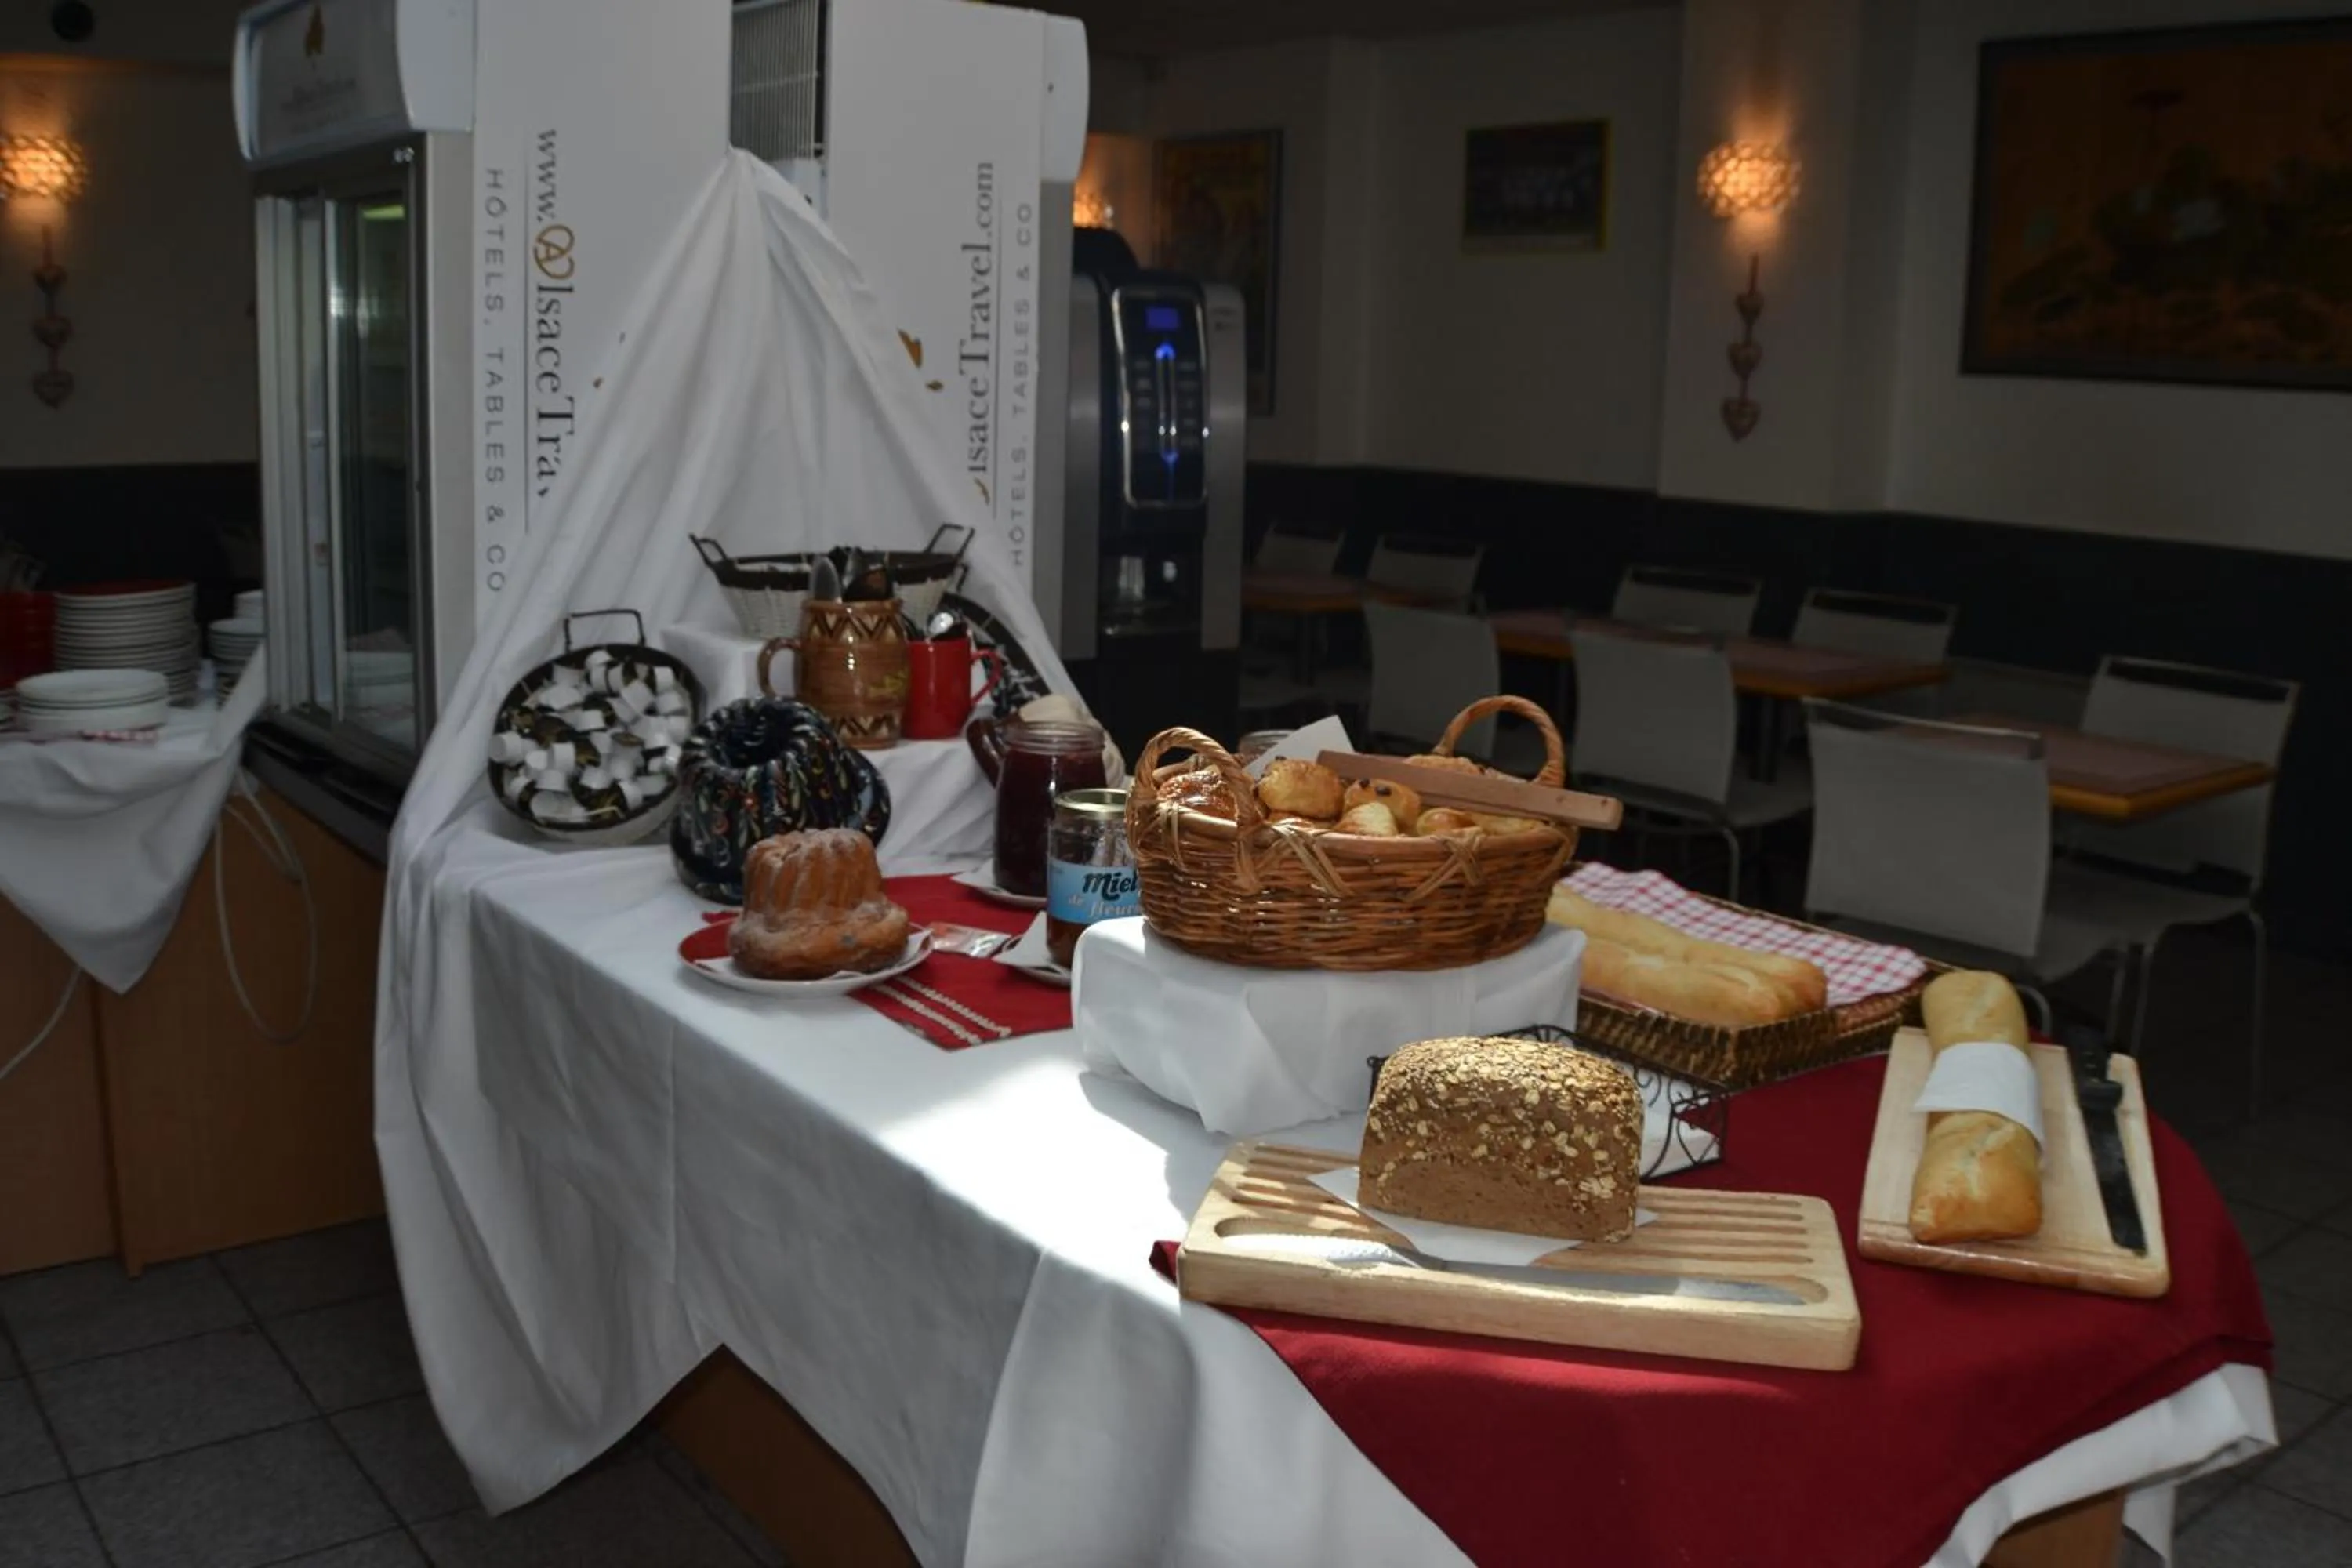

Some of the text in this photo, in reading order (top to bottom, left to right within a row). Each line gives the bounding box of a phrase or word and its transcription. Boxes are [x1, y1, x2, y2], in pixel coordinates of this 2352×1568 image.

[1017, 204, 1032, 246] CO
[1016, 265, 1030, 281] &
[1013, 299, 1029, 418] TABLES
[484, 349, 505, 484] TABLES
[486, 505, 504, 524] &
[486, 545, 505, 593] CO
[1083, 869, 1138, 901] Miel
